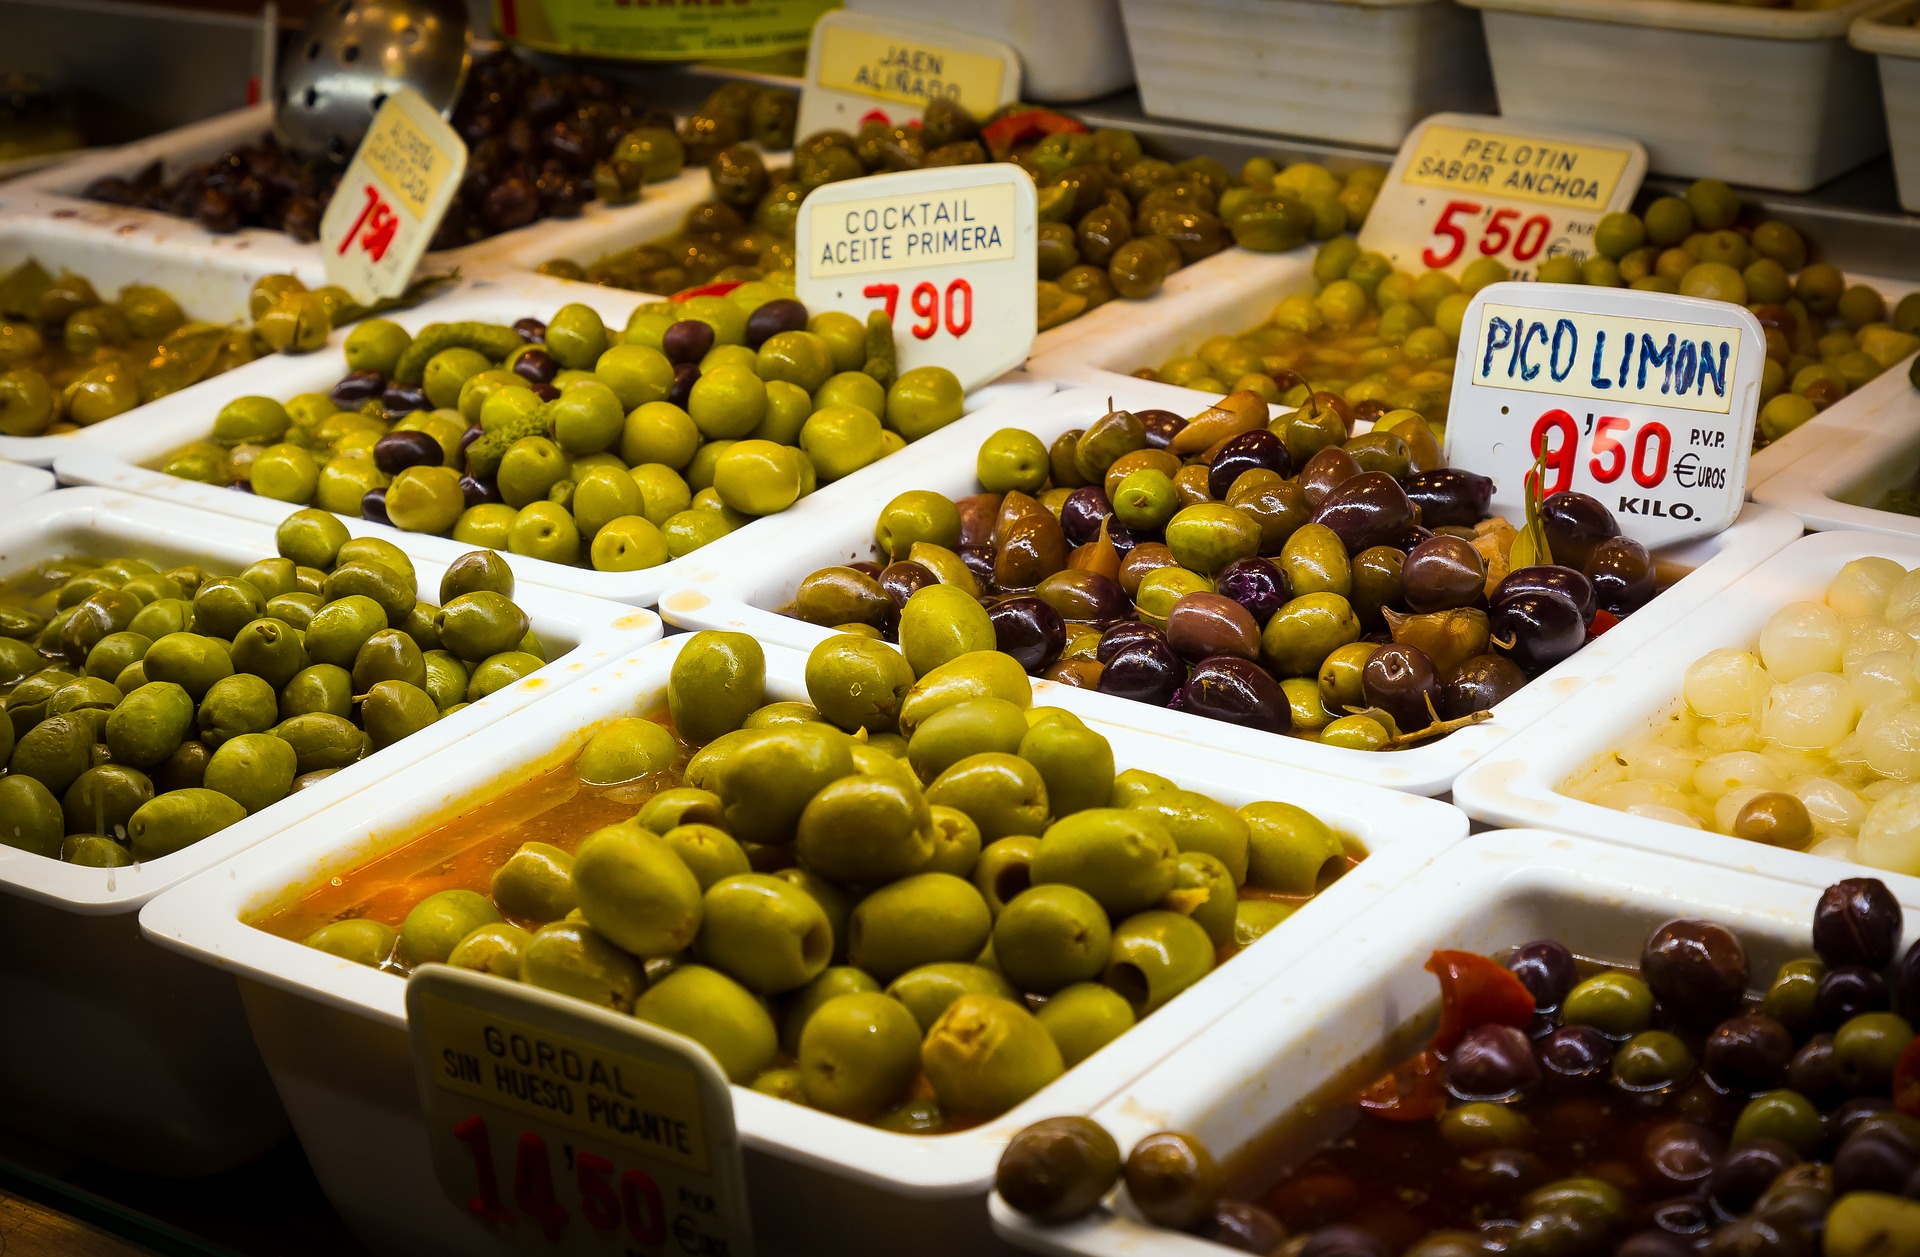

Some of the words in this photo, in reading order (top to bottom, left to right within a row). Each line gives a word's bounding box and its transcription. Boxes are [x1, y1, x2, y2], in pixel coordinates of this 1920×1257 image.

[1463, 137, 1578, 172] PELOTIN
[1417, 156, 1494, 184] SABOR
[1503, 170, 1599, 201] ANCHOA
[845, 199, 975, 235] COCKTAIL
[821, 236, 892, 265] ACEITE
[907, 225, 1002, 256] PRIMERA
[1481, 316, 1579, 383] PICO
[1590, 330, 1731, 398] LIMON
[1689, 428, 1726, 448] P.V.P.
[1618, 496, 1703, 522] KILO.
[484, 1026, 635, 1098] GORDAL
[443, 1049, 481, 1084] SIN
[495, 1064, 574, 1115] HUESO
[588, 1094, 692, 1155] PICANTE
